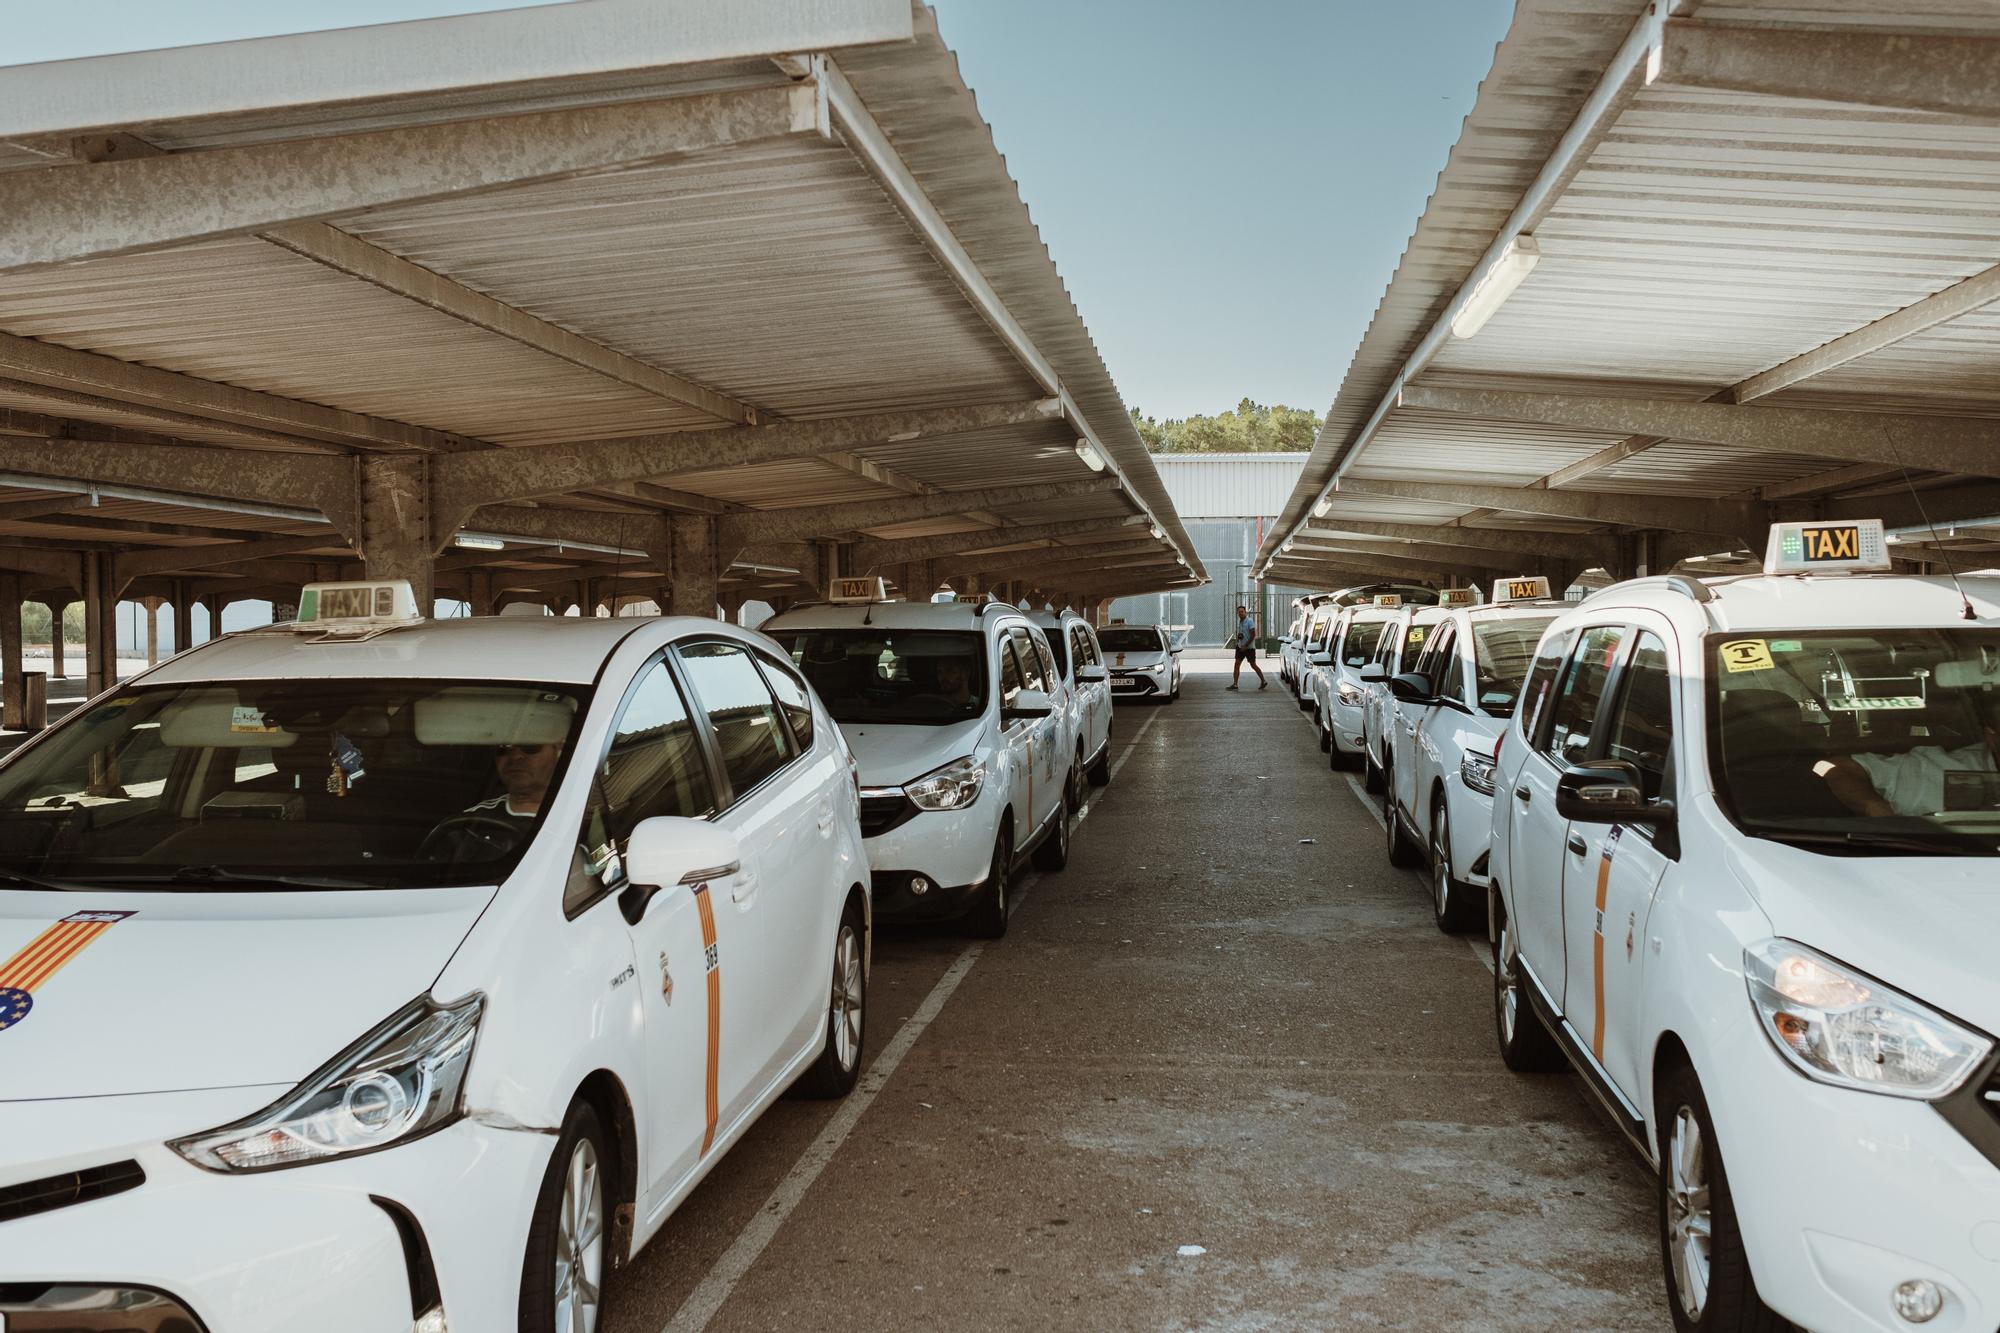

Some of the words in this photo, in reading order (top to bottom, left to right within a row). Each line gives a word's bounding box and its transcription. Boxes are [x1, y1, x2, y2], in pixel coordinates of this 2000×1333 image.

[1803, 529, 1859, 559] TAXI
[843, 581, 868, 596] TAXI
[1509, 582, 1537, 598] TAXI
[322, 589, 369, 617] TAXI
[705, 943, 718, 970] 369
